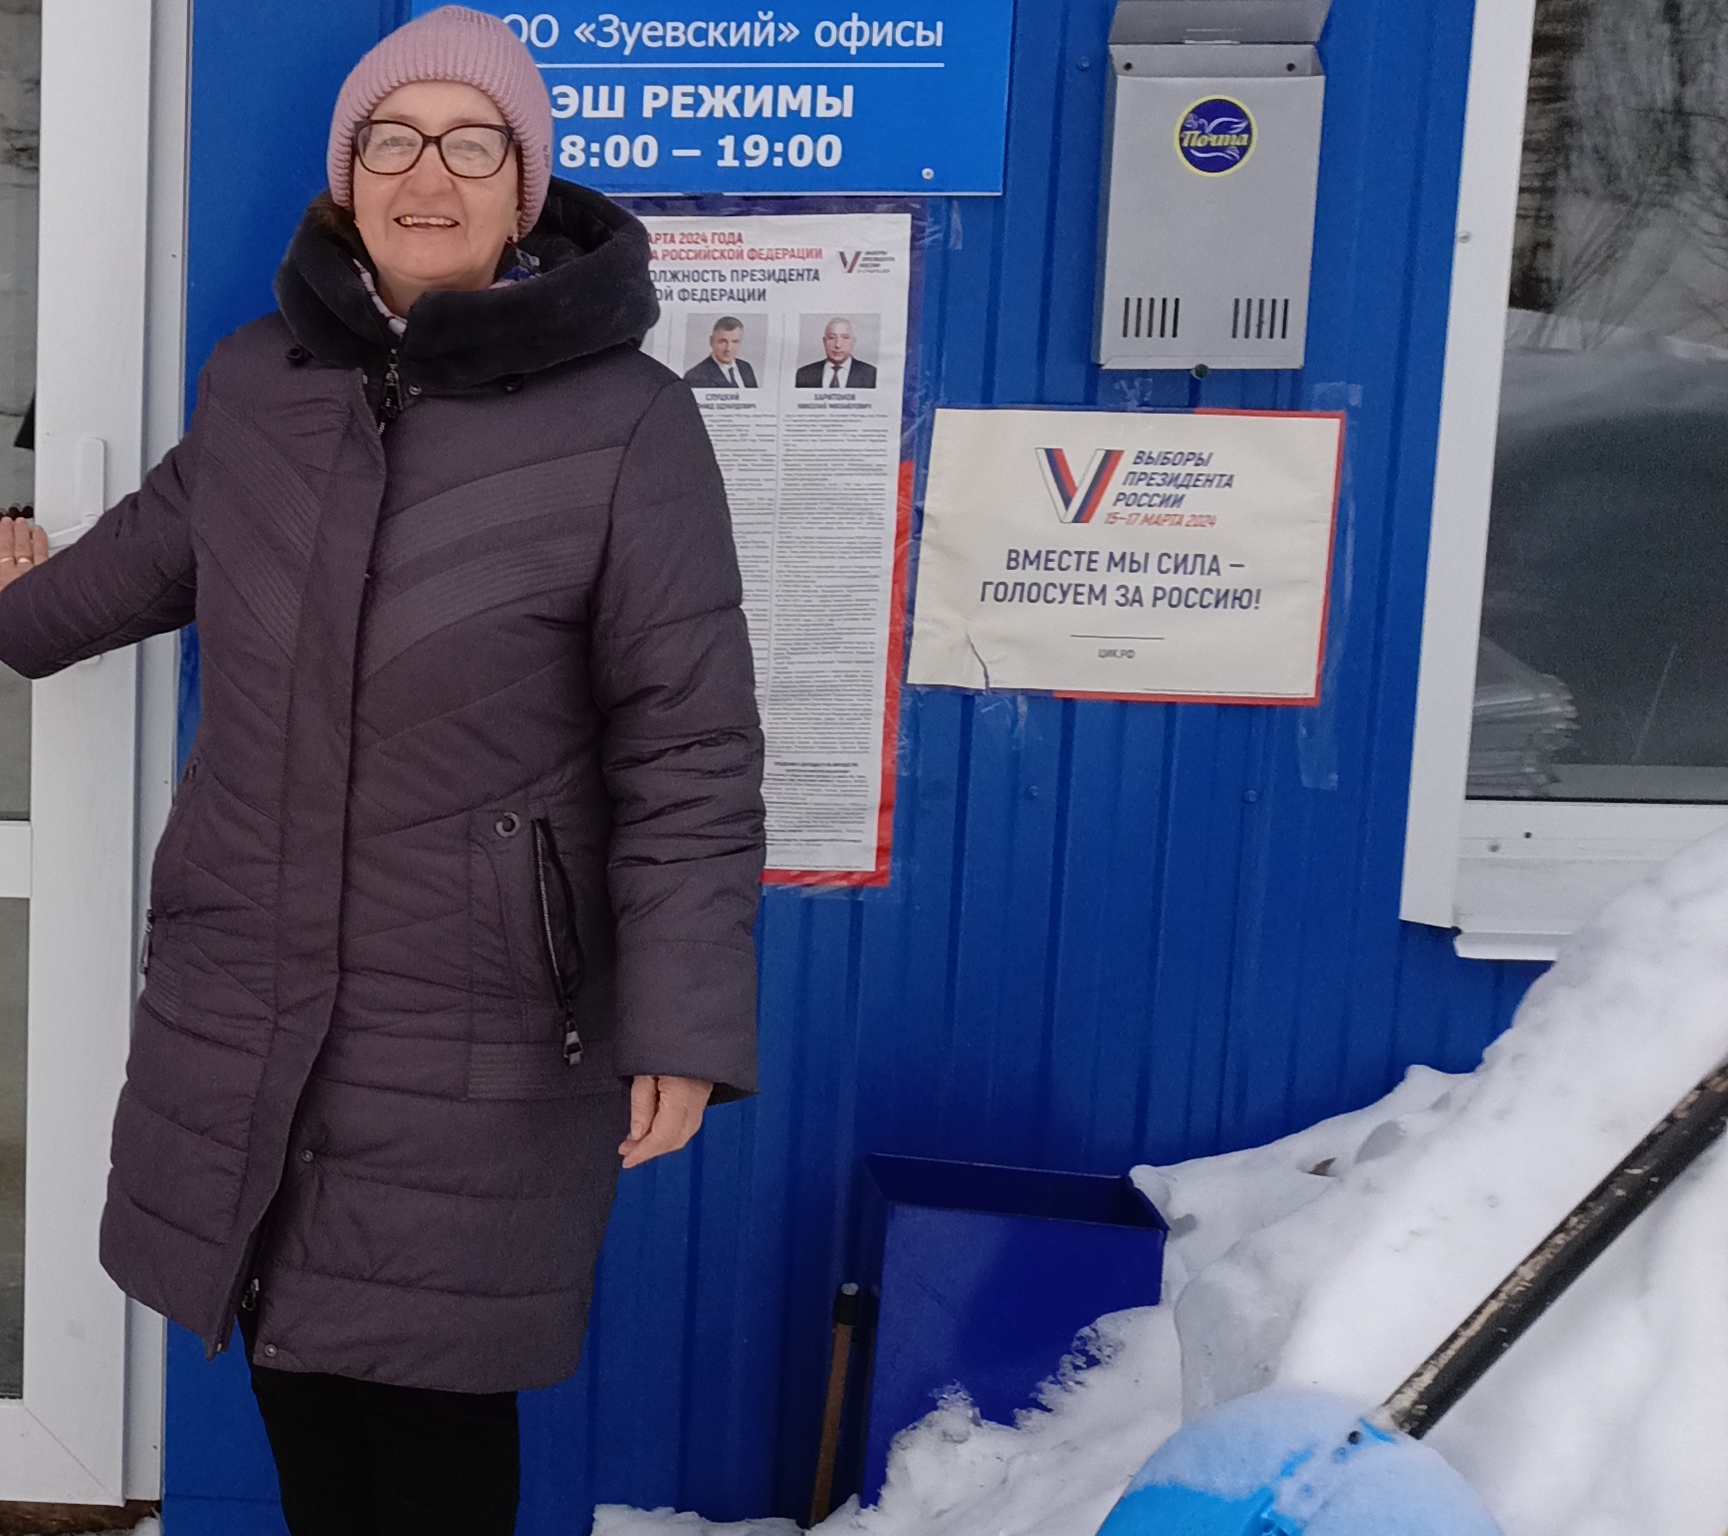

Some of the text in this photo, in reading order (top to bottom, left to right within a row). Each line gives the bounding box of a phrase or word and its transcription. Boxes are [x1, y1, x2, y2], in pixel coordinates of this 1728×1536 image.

[574, 11, 801, 55] «Зуевский»
[814, 12, 944, 55] офисы
[642, 85, 854, 118] РЕЖИМЫ
[559, 134, 659, 168] 8:00
[717, 134, 843, 167] 19:00
[711, 231, 744, 245] ГОДА
[661, 246, 744, 260] РОССИЙСКОЙ
[747, 247, 823, 261] ФЕДЕРАЦИИ
[648, 268, 820, 283] ОЛЖНОСТЬ ПРЕЗИДЕНТА
[677, 287, 766, 303] ФЕДЕРАЦИИ
[1133, 450, 1213, 466] ВЫБОРЫ
[1122, 470, 1234, 489] ПРЕЗИДЕНТА
[1112, 492, 1185, 508] РОССИИ
[1139, 513, 1182, 525] МАРТА
[1184, 514, 1217, 527] 2024
[1005, 548, 1100, 573] ВМЕСТЕ
[1106, 551, 1149, 573] МЫ
[1156, 552, 1221, 576] СИЛА
[980, 580, 1262, 611] ГОЛОСУЕМ ЗА РОССИЮ!
